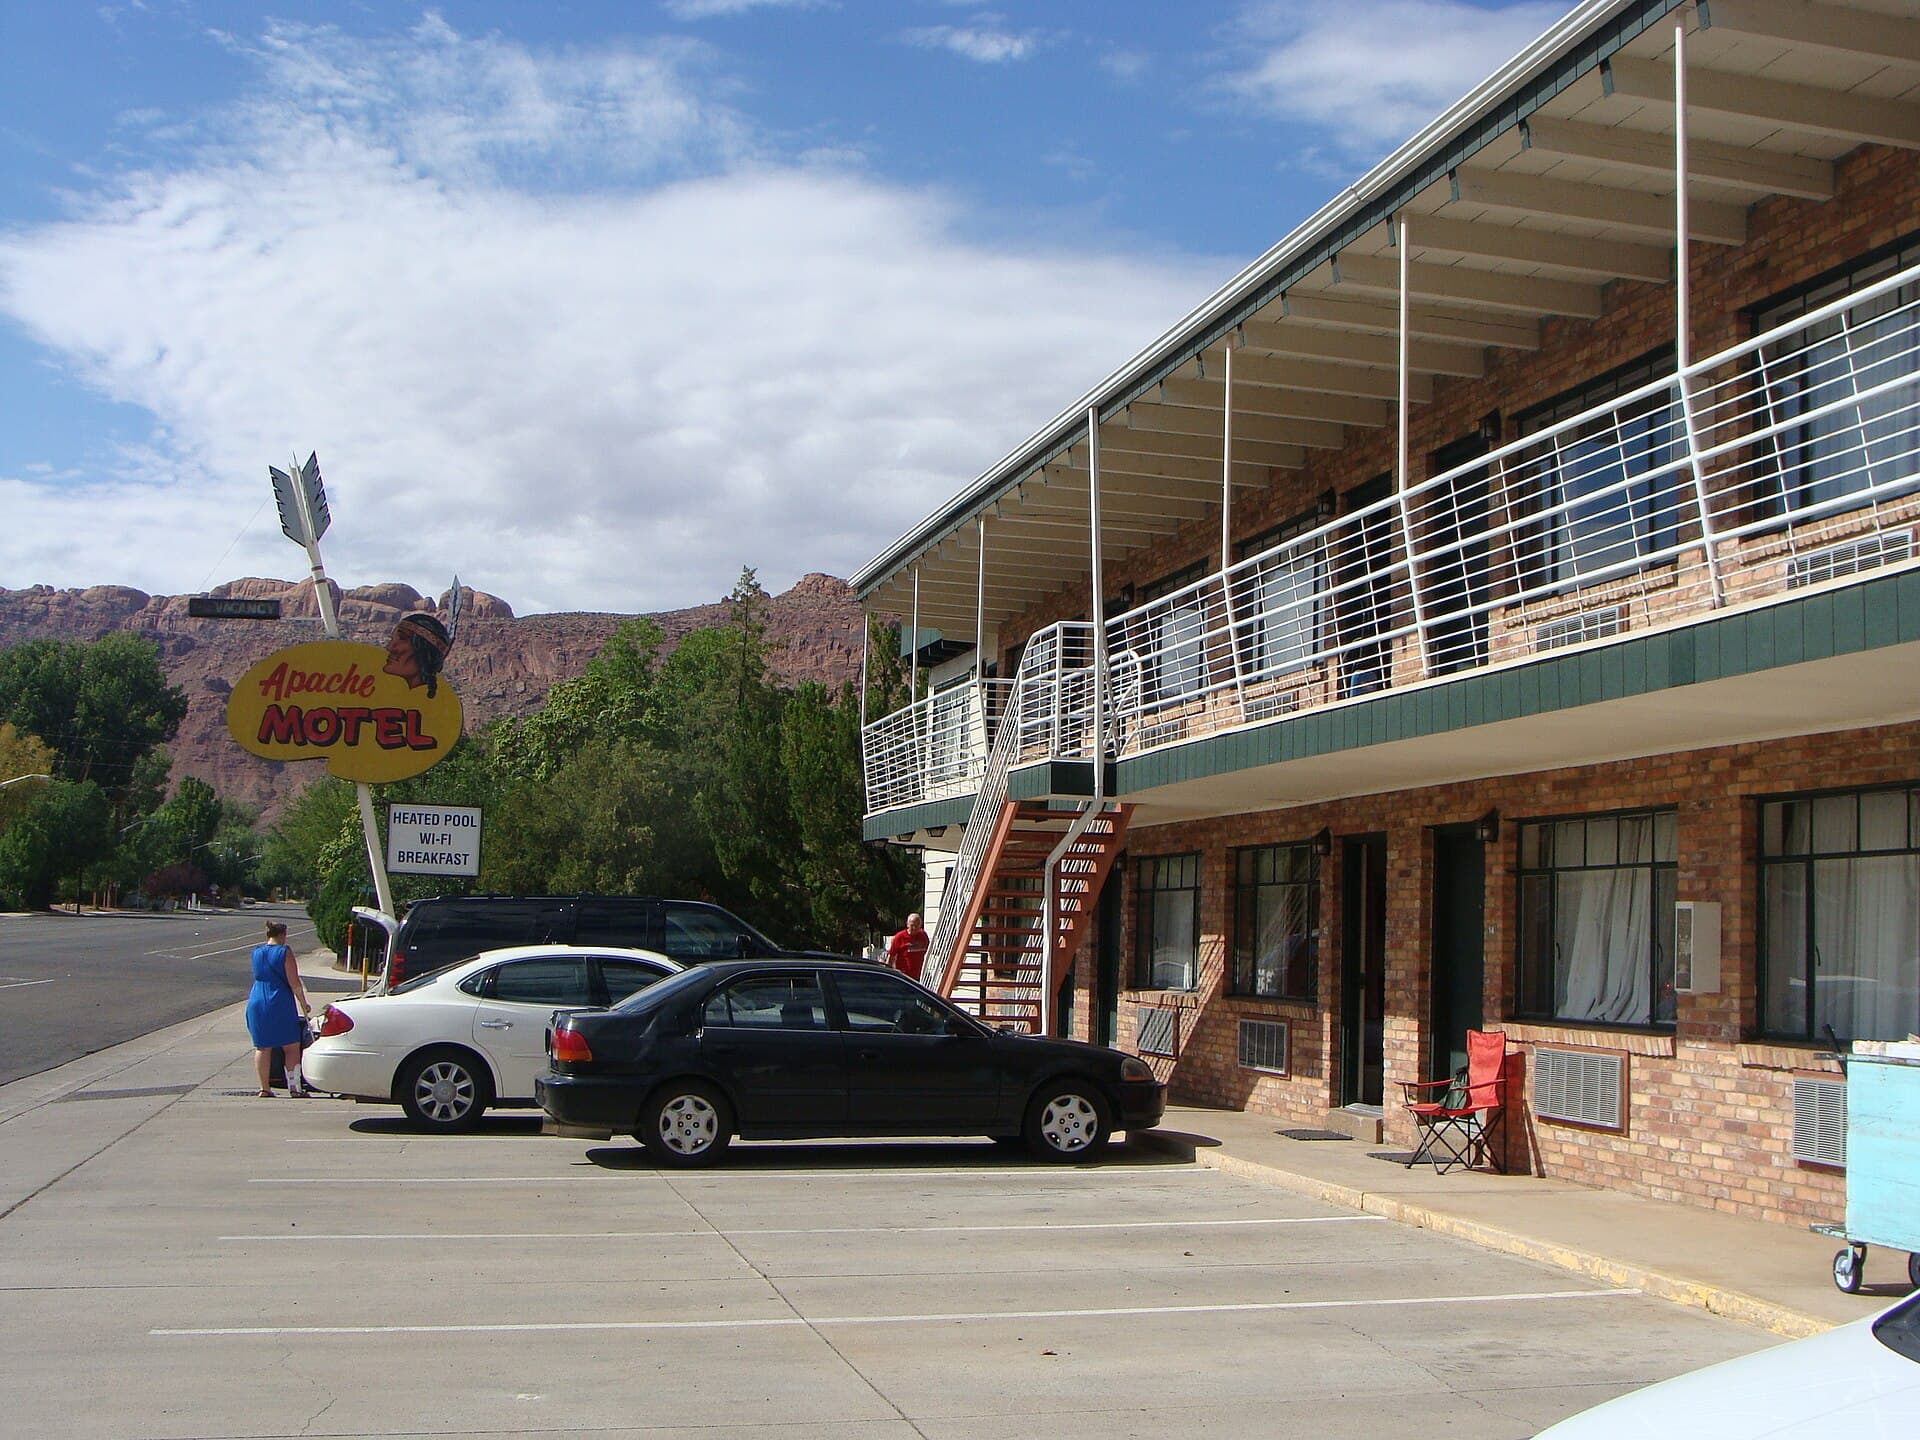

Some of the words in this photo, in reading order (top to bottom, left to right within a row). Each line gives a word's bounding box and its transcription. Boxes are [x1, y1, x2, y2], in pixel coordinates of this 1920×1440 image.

[259, 662, 376, 701] Apache
[257, 704, 437, 750] MOTEL
[393, 812, 440, 826] HEATED
[444, 814, 478, 828] POOL
[420, 832, 452, 845] WI-FI
[398, 850, 470, 866] BREAKFAST
